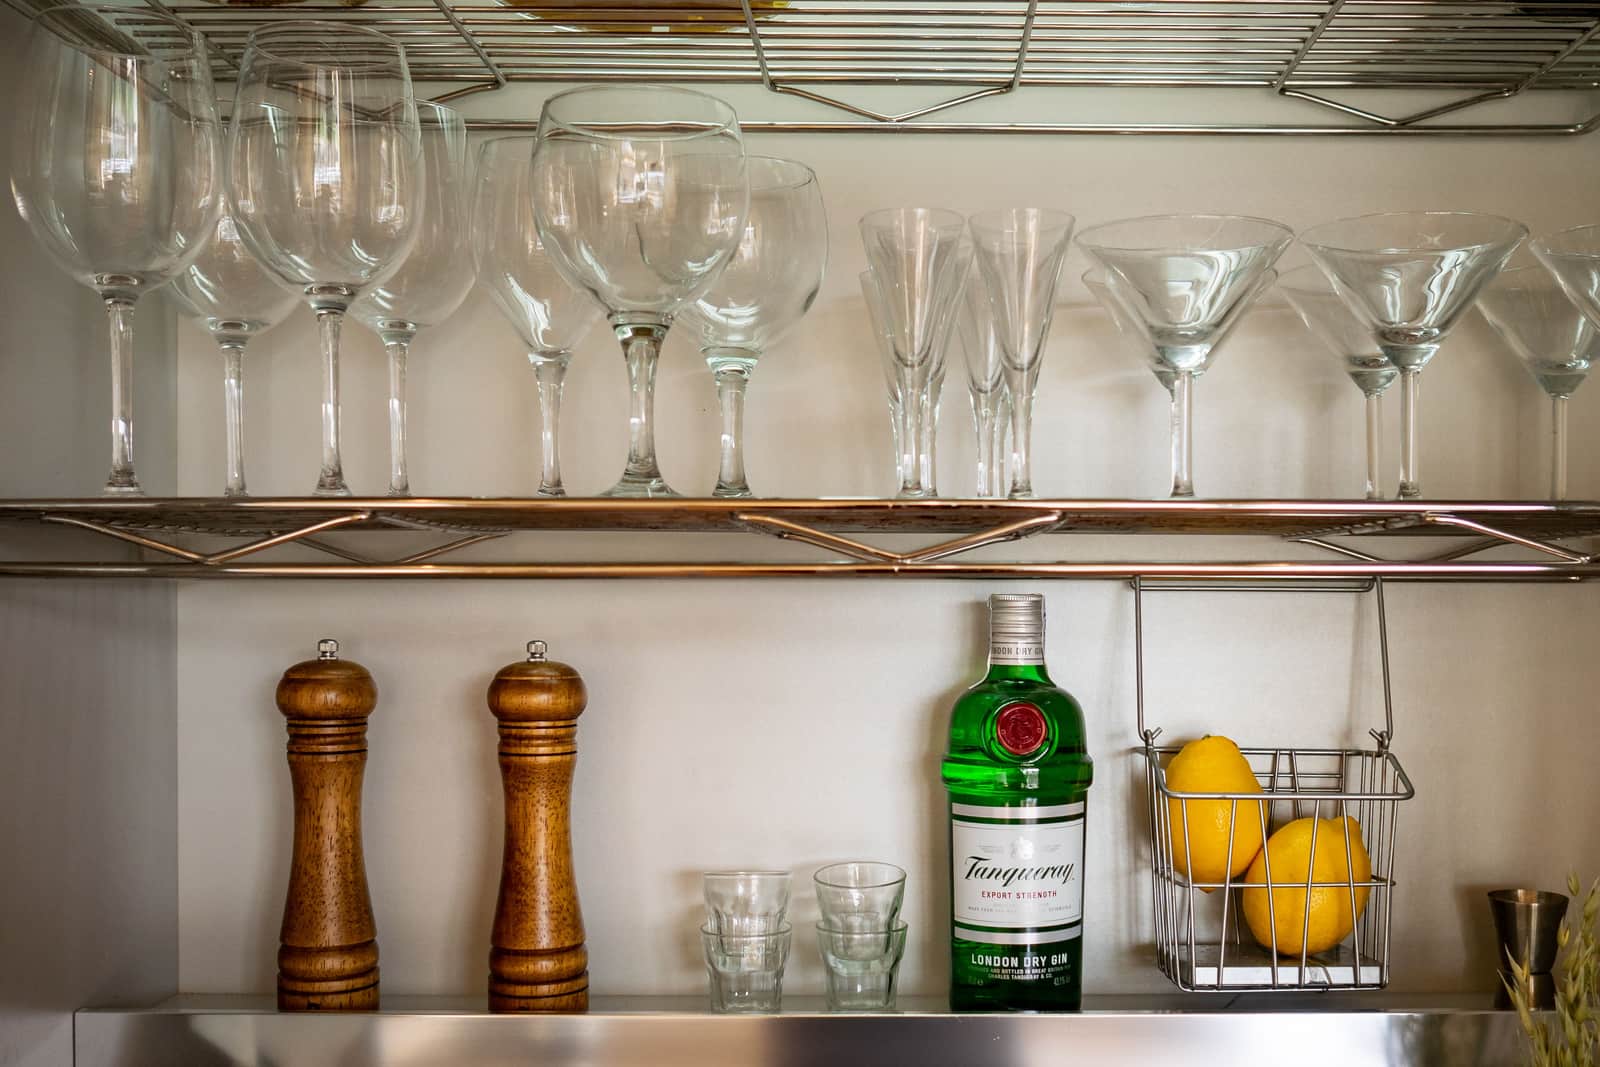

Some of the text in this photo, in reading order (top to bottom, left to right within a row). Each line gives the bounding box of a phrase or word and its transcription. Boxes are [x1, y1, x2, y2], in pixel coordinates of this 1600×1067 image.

[1016, 647, 1032, 655] DRY
[965, 856, 1074, 887] Tanqueray
[981, 890, 1057, 900] EXPORT STRENGTH
[971, 952, 1068, 968] LONDON DRY GIN
